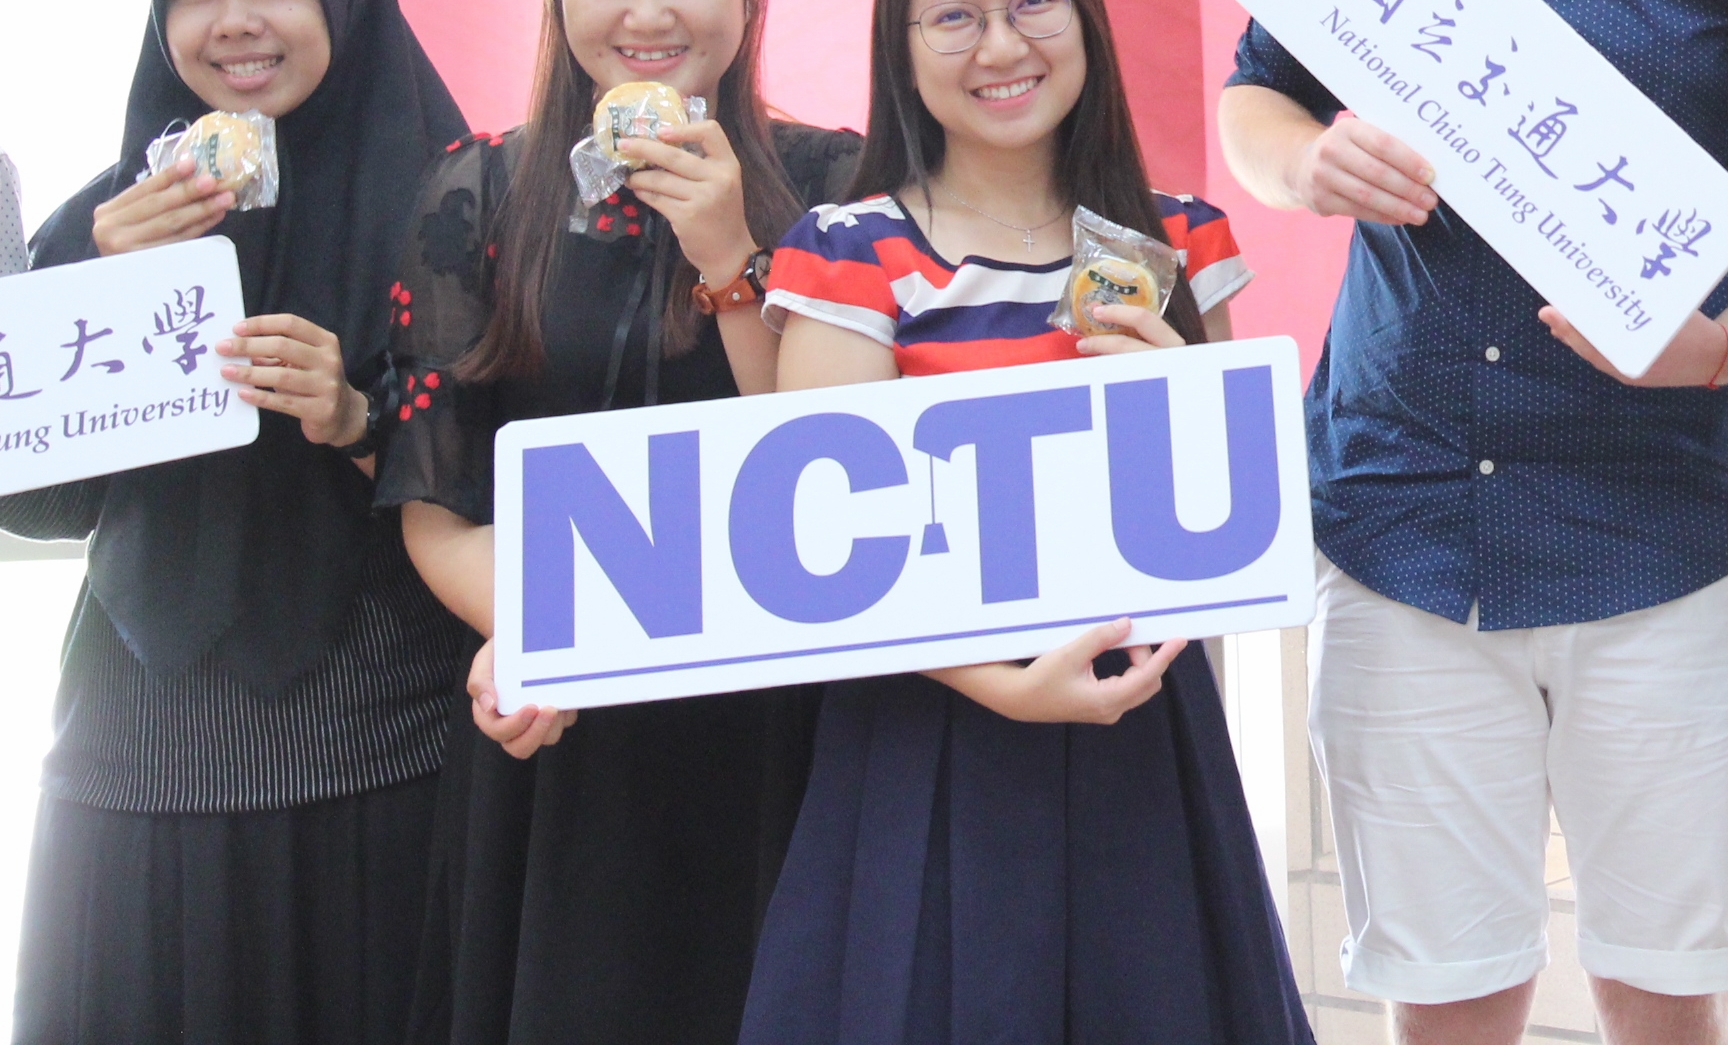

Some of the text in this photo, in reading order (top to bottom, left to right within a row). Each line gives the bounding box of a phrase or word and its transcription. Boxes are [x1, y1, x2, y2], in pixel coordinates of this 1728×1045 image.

[1319, 6, 1653, 332] National Chiao Tung University
[0, 387, 230, 454] ung University
[521, 364, 1282, 654] NCTU
